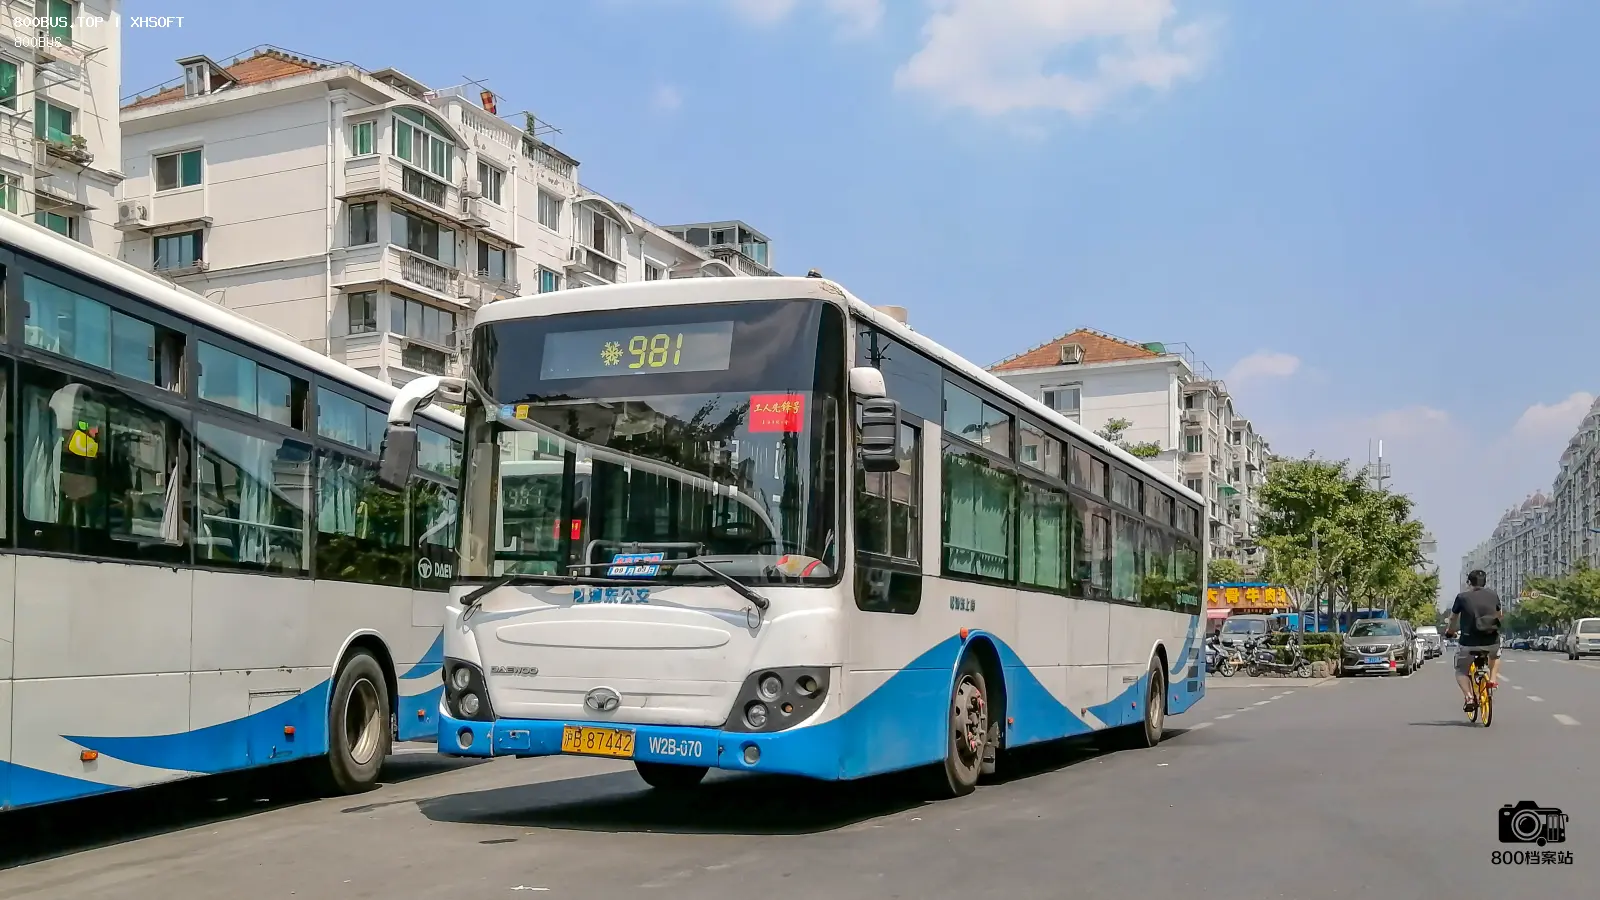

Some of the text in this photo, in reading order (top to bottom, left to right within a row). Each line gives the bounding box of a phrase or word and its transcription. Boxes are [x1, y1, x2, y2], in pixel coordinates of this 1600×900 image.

[628, 333, 684, 369] 981
[753, 400, 800, 414] 工人先锋号
[490, 665, 538, 678] DAEWOO
[649, 737, 703, 758] W2B-070
